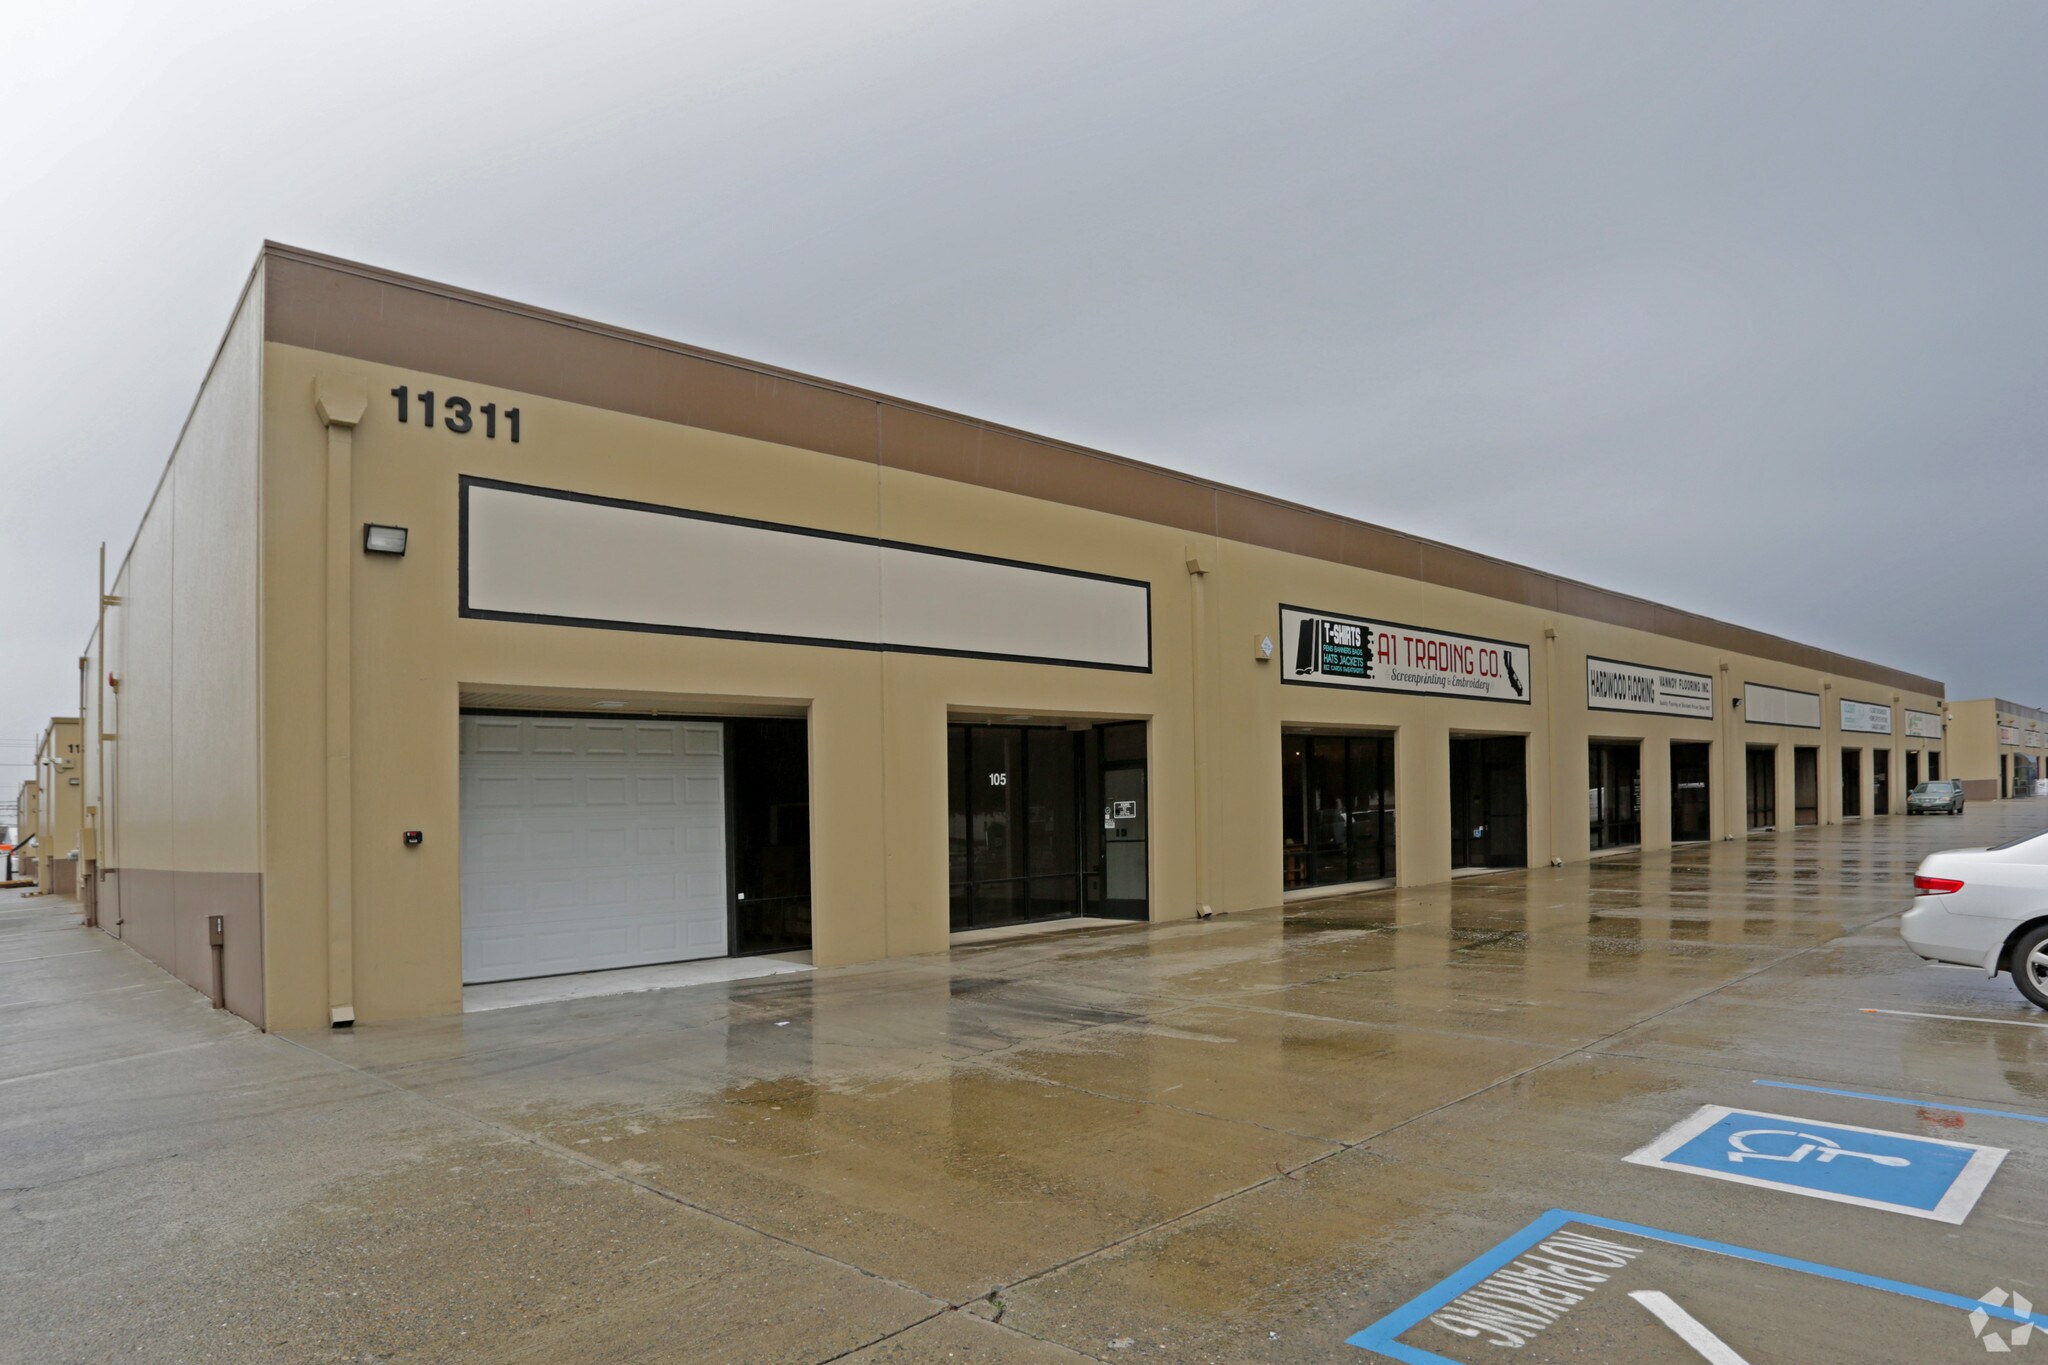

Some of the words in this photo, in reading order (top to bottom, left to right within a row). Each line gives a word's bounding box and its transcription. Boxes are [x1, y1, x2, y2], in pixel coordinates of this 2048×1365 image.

[391, 385, 520, 443] 11311
[1324, 622, 1361, 647] T-SHIRTS
[1323, 653, 1338, 664] HATS
[1339, 656, 1364, 667] JACKETS
[1378, 633, 1397, 666] A1
[1403, 636, 1474, 675] TRADING
[1479, 648, 1502, 679] CO.
[1391, 668, 1446, 689] Screenprinting
[1452, 674, 1490, 693] Embroidery
[1590, 669, 1626, 700] HARDWOOD
[1628, 675, 1655, 704] FLOORING
[1659, 675, 1677, 689] VANNOY
[1679, 678, 1700, 692] FLOORING
[989, 773, 1007, 786] 105
[1539, 1230, 1644, 1268] NO
[1430, 1254, 1612, 1348] PARKING
